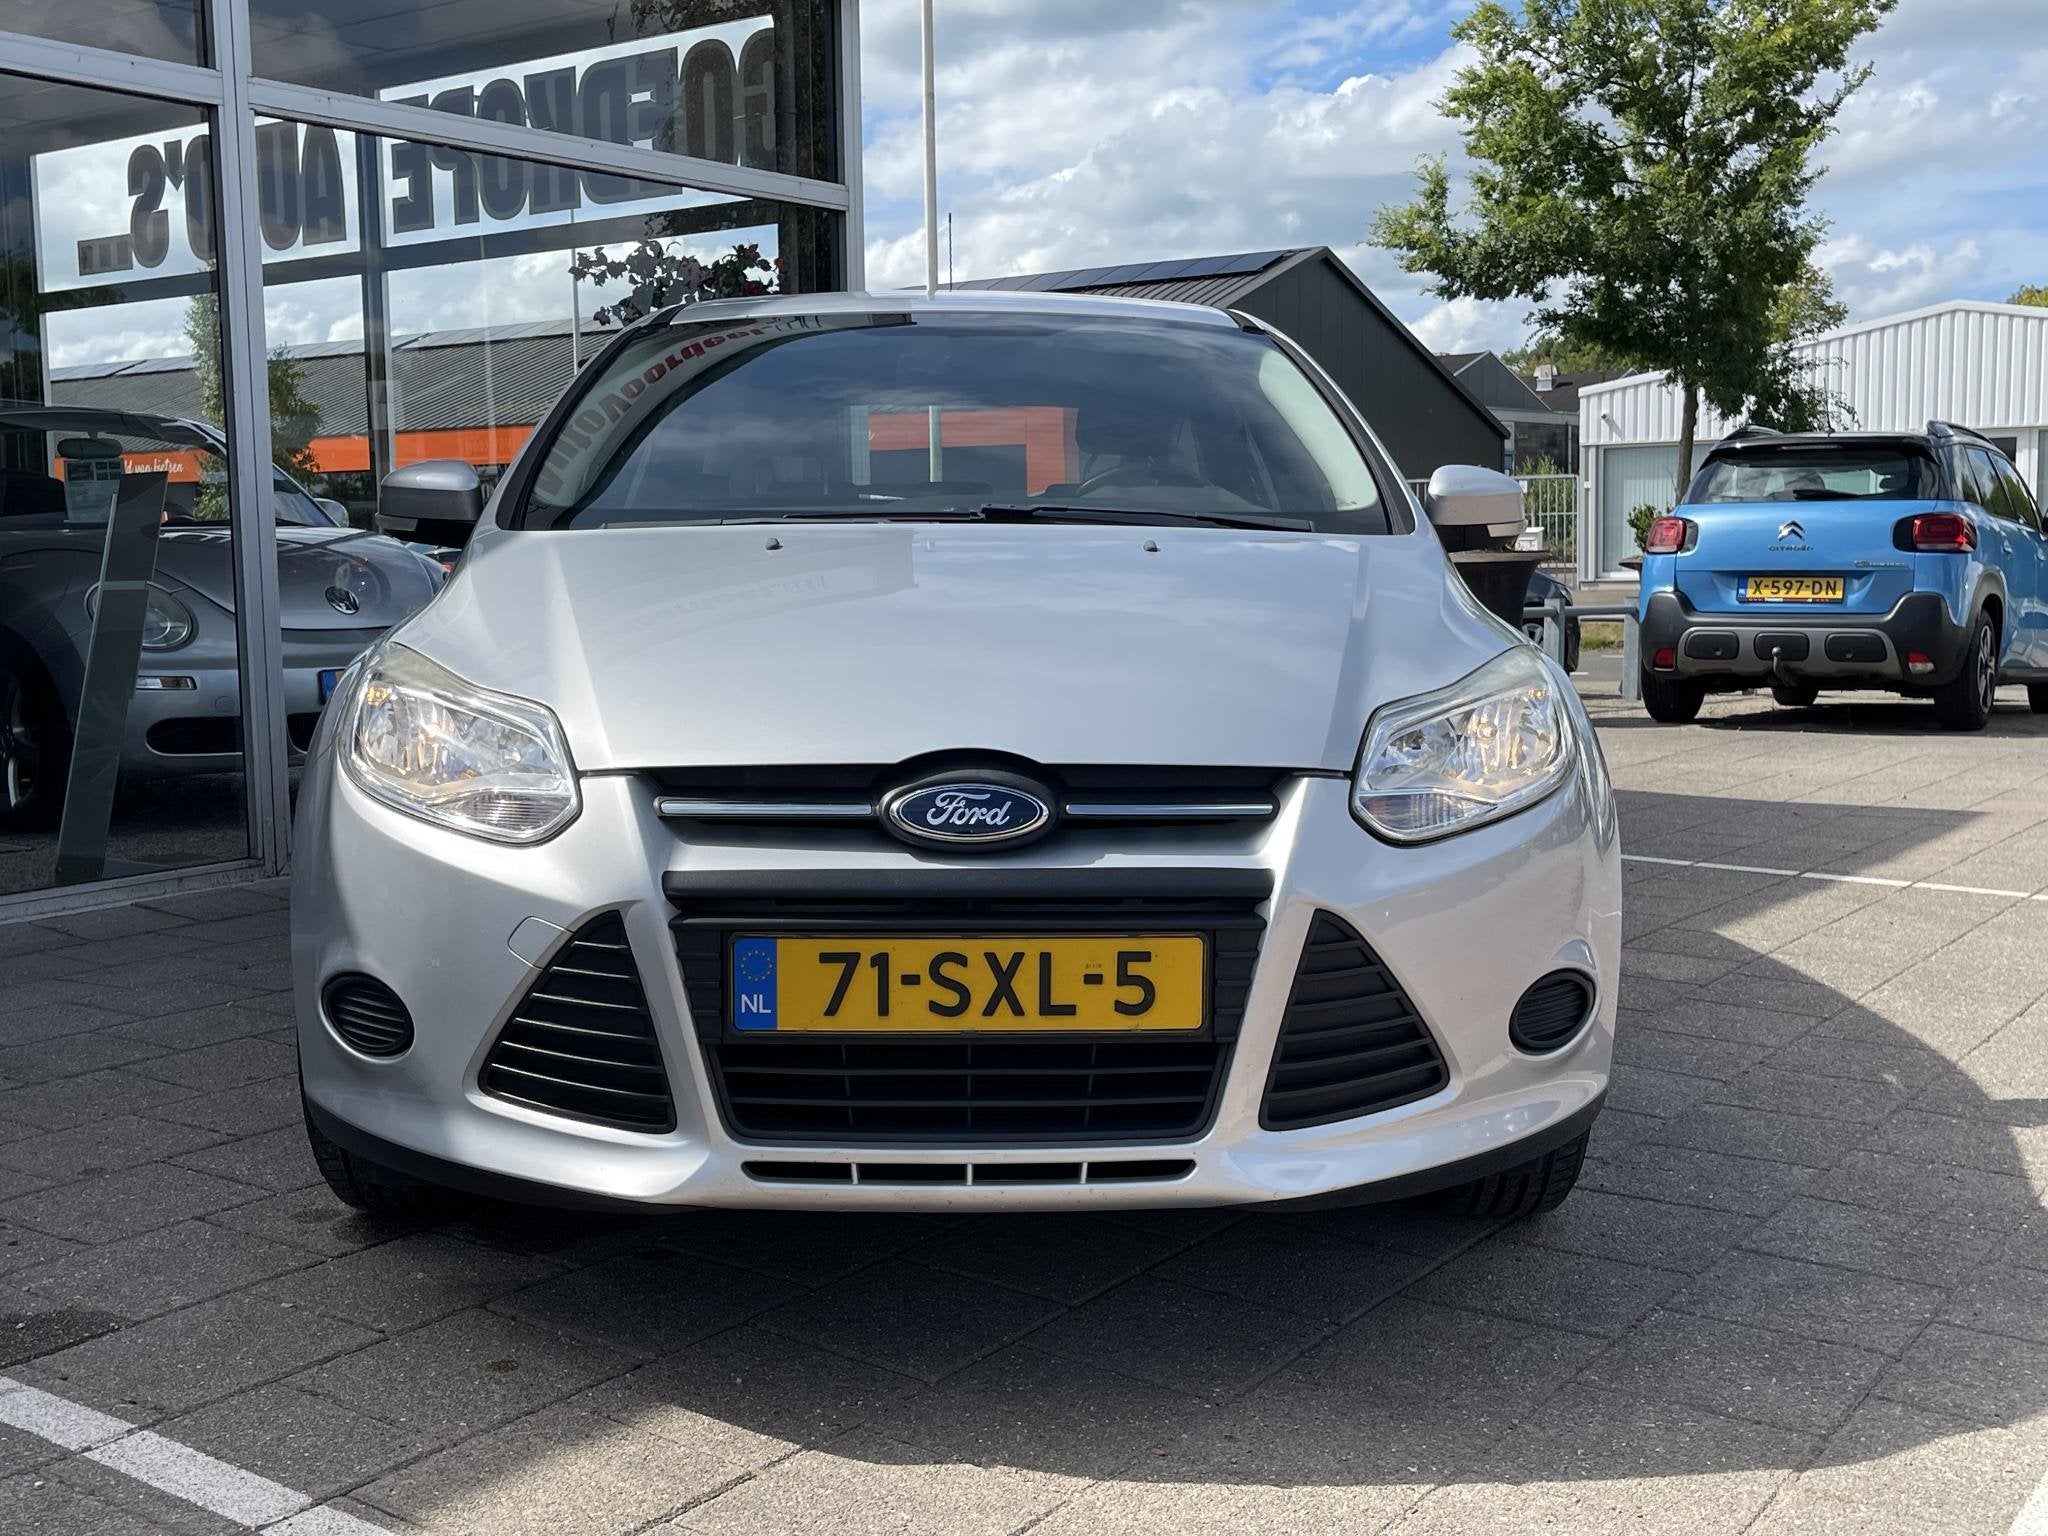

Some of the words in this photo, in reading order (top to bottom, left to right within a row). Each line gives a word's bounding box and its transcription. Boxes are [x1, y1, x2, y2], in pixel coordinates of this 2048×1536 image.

[1752, 580, 1837, 596] X-597-DN
[926, 791, 1012, 827] Ford
[818, 951, 1156, 1018] 71-SXL-5
[741, 993, 772, 1014] NL
